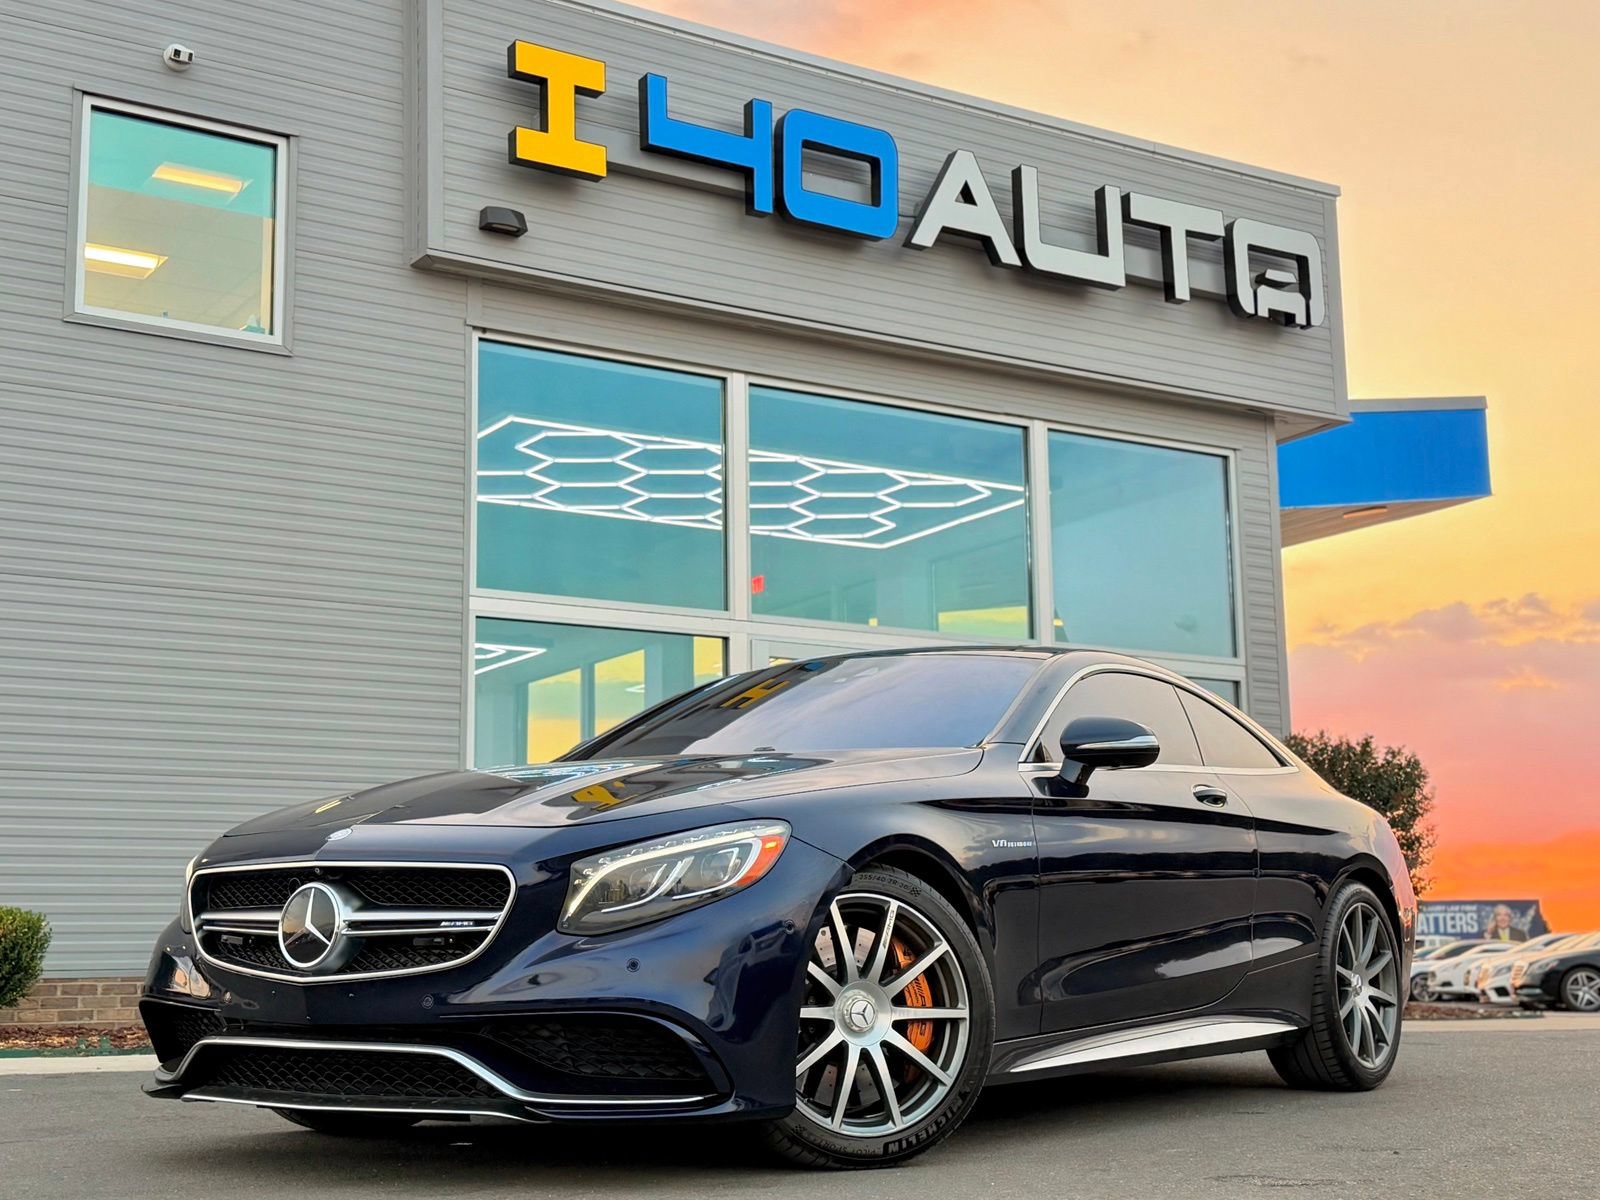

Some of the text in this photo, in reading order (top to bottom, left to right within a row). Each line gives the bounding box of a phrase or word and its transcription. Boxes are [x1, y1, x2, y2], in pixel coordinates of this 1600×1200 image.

[506, 38, 607, 182] I
[639, 72, 899, 241] 40
[1416, 912, 1479, 933] ATTERS
[888, 1096, 963, 1154] MICHELIN
